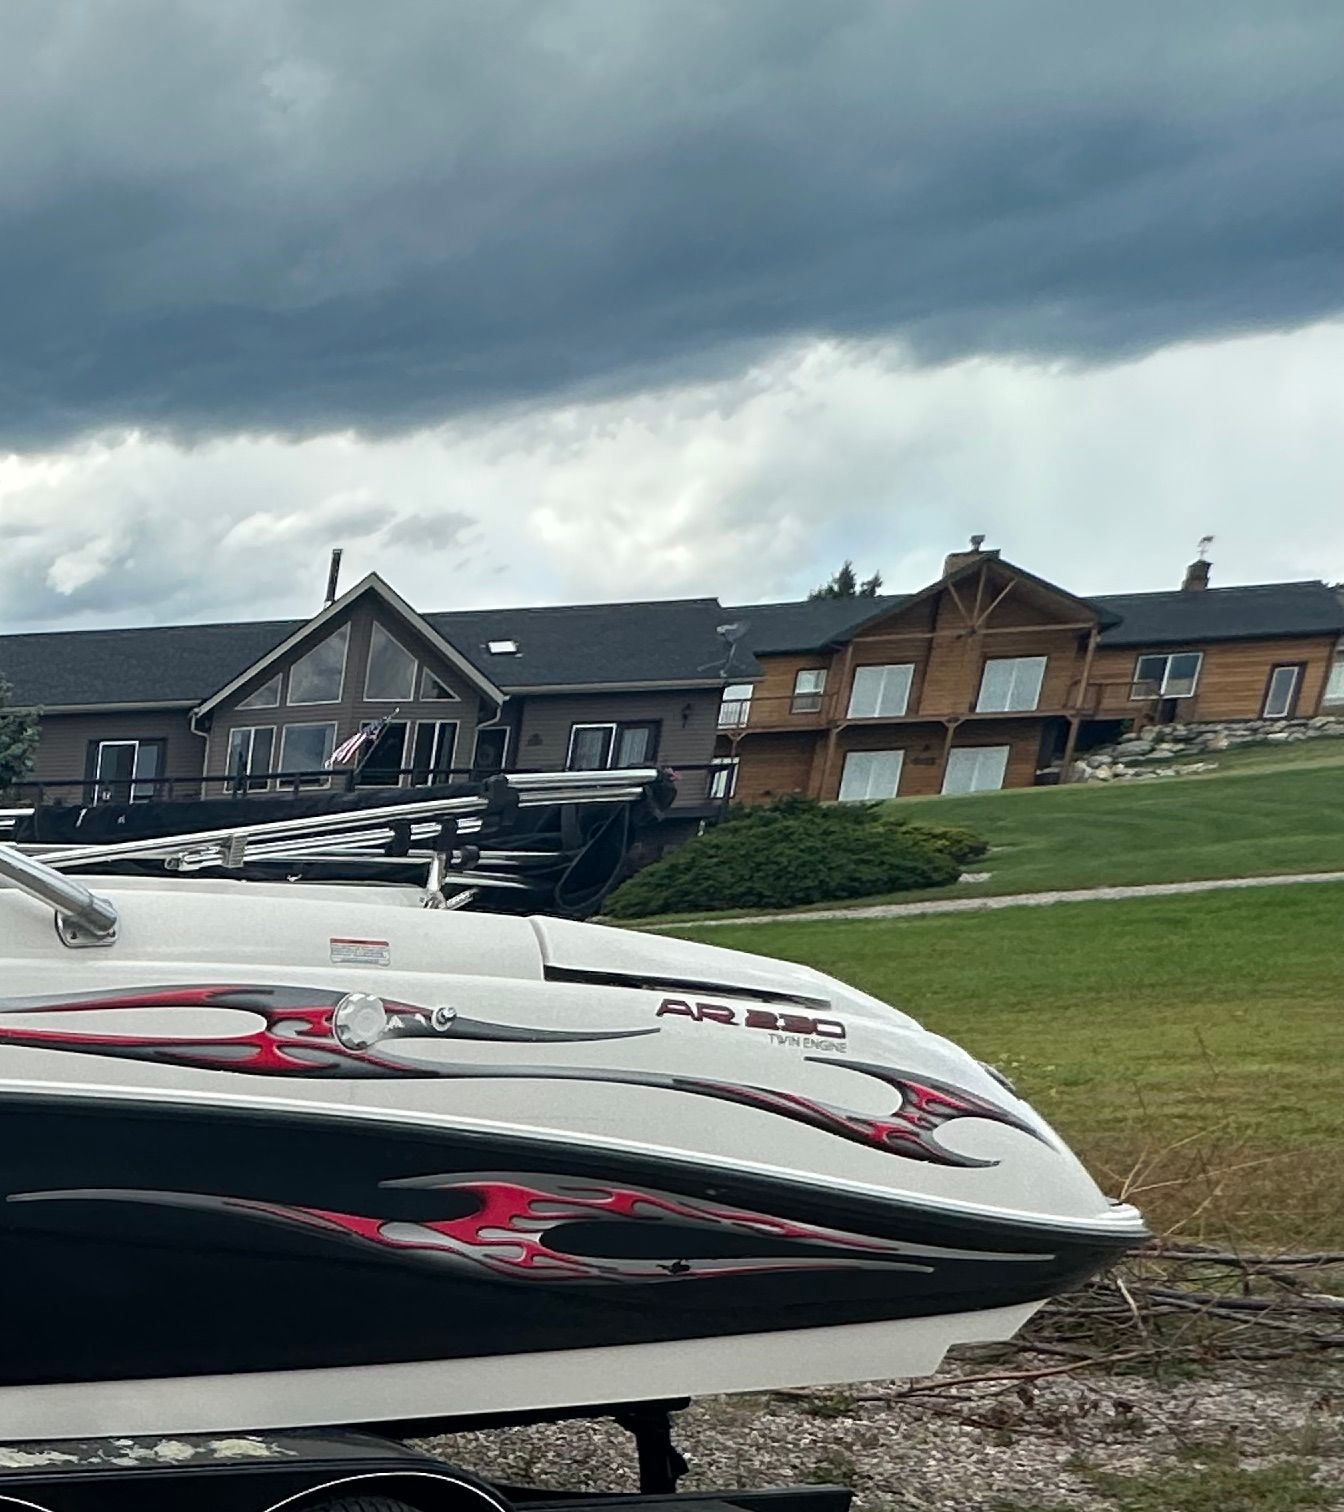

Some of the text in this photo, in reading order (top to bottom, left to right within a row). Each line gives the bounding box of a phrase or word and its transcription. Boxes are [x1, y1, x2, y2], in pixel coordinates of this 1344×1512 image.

[656, 998, 846, 1040] AR 230
[768, 1033, 848, 1054] TWIN ENGINE
